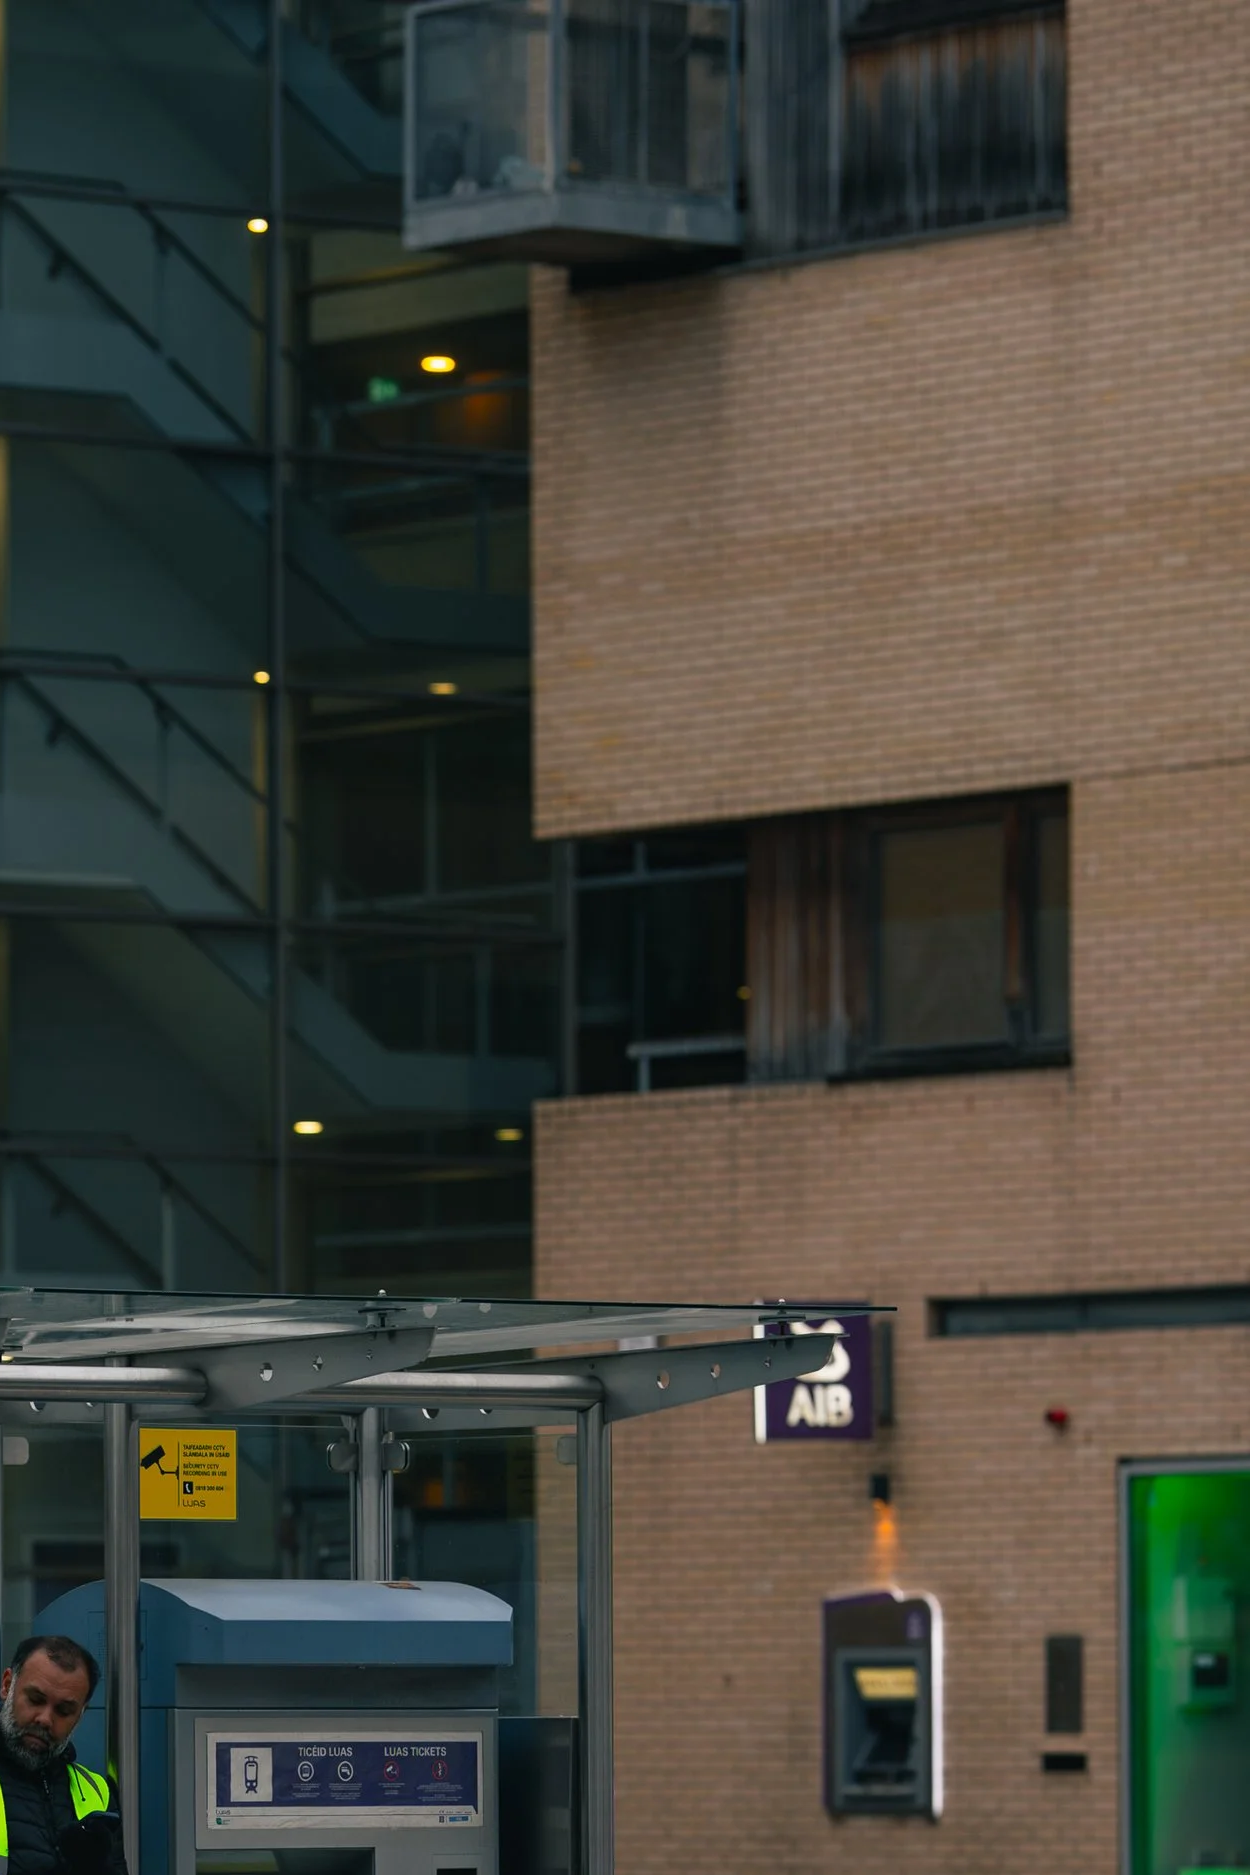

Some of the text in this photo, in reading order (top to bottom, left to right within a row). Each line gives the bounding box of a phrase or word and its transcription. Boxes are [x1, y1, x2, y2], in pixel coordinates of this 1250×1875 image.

[786, 1383, 854, 1428] AIB
[182, 1500, 206, 1508] LUAS
[298, 1745, 353, 1757] TICÉID LUAS
[384, 1746, 447, 1757] LUAS TICKETS
